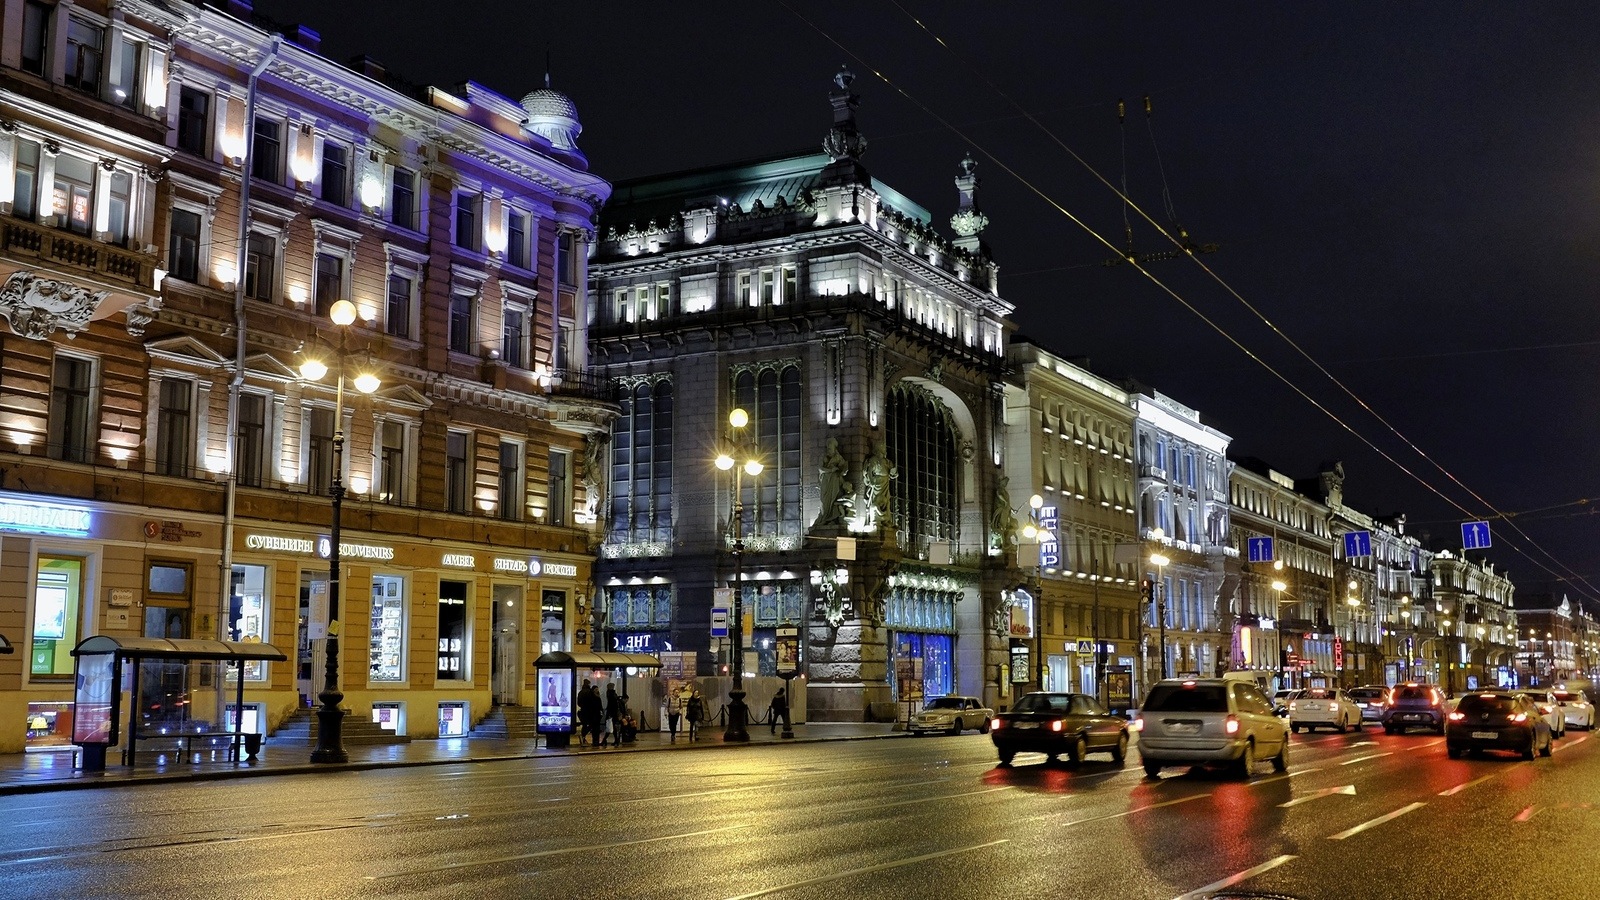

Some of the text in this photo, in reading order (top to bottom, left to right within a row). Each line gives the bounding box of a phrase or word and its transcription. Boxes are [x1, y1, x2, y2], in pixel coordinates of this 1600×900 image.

[246, 534, 314, 553] СУВЕНИРЫ
[443, 554, 475, 567] AMBER
[494, 558, 577, 576] ЯНТАРЬ РОССИИ
